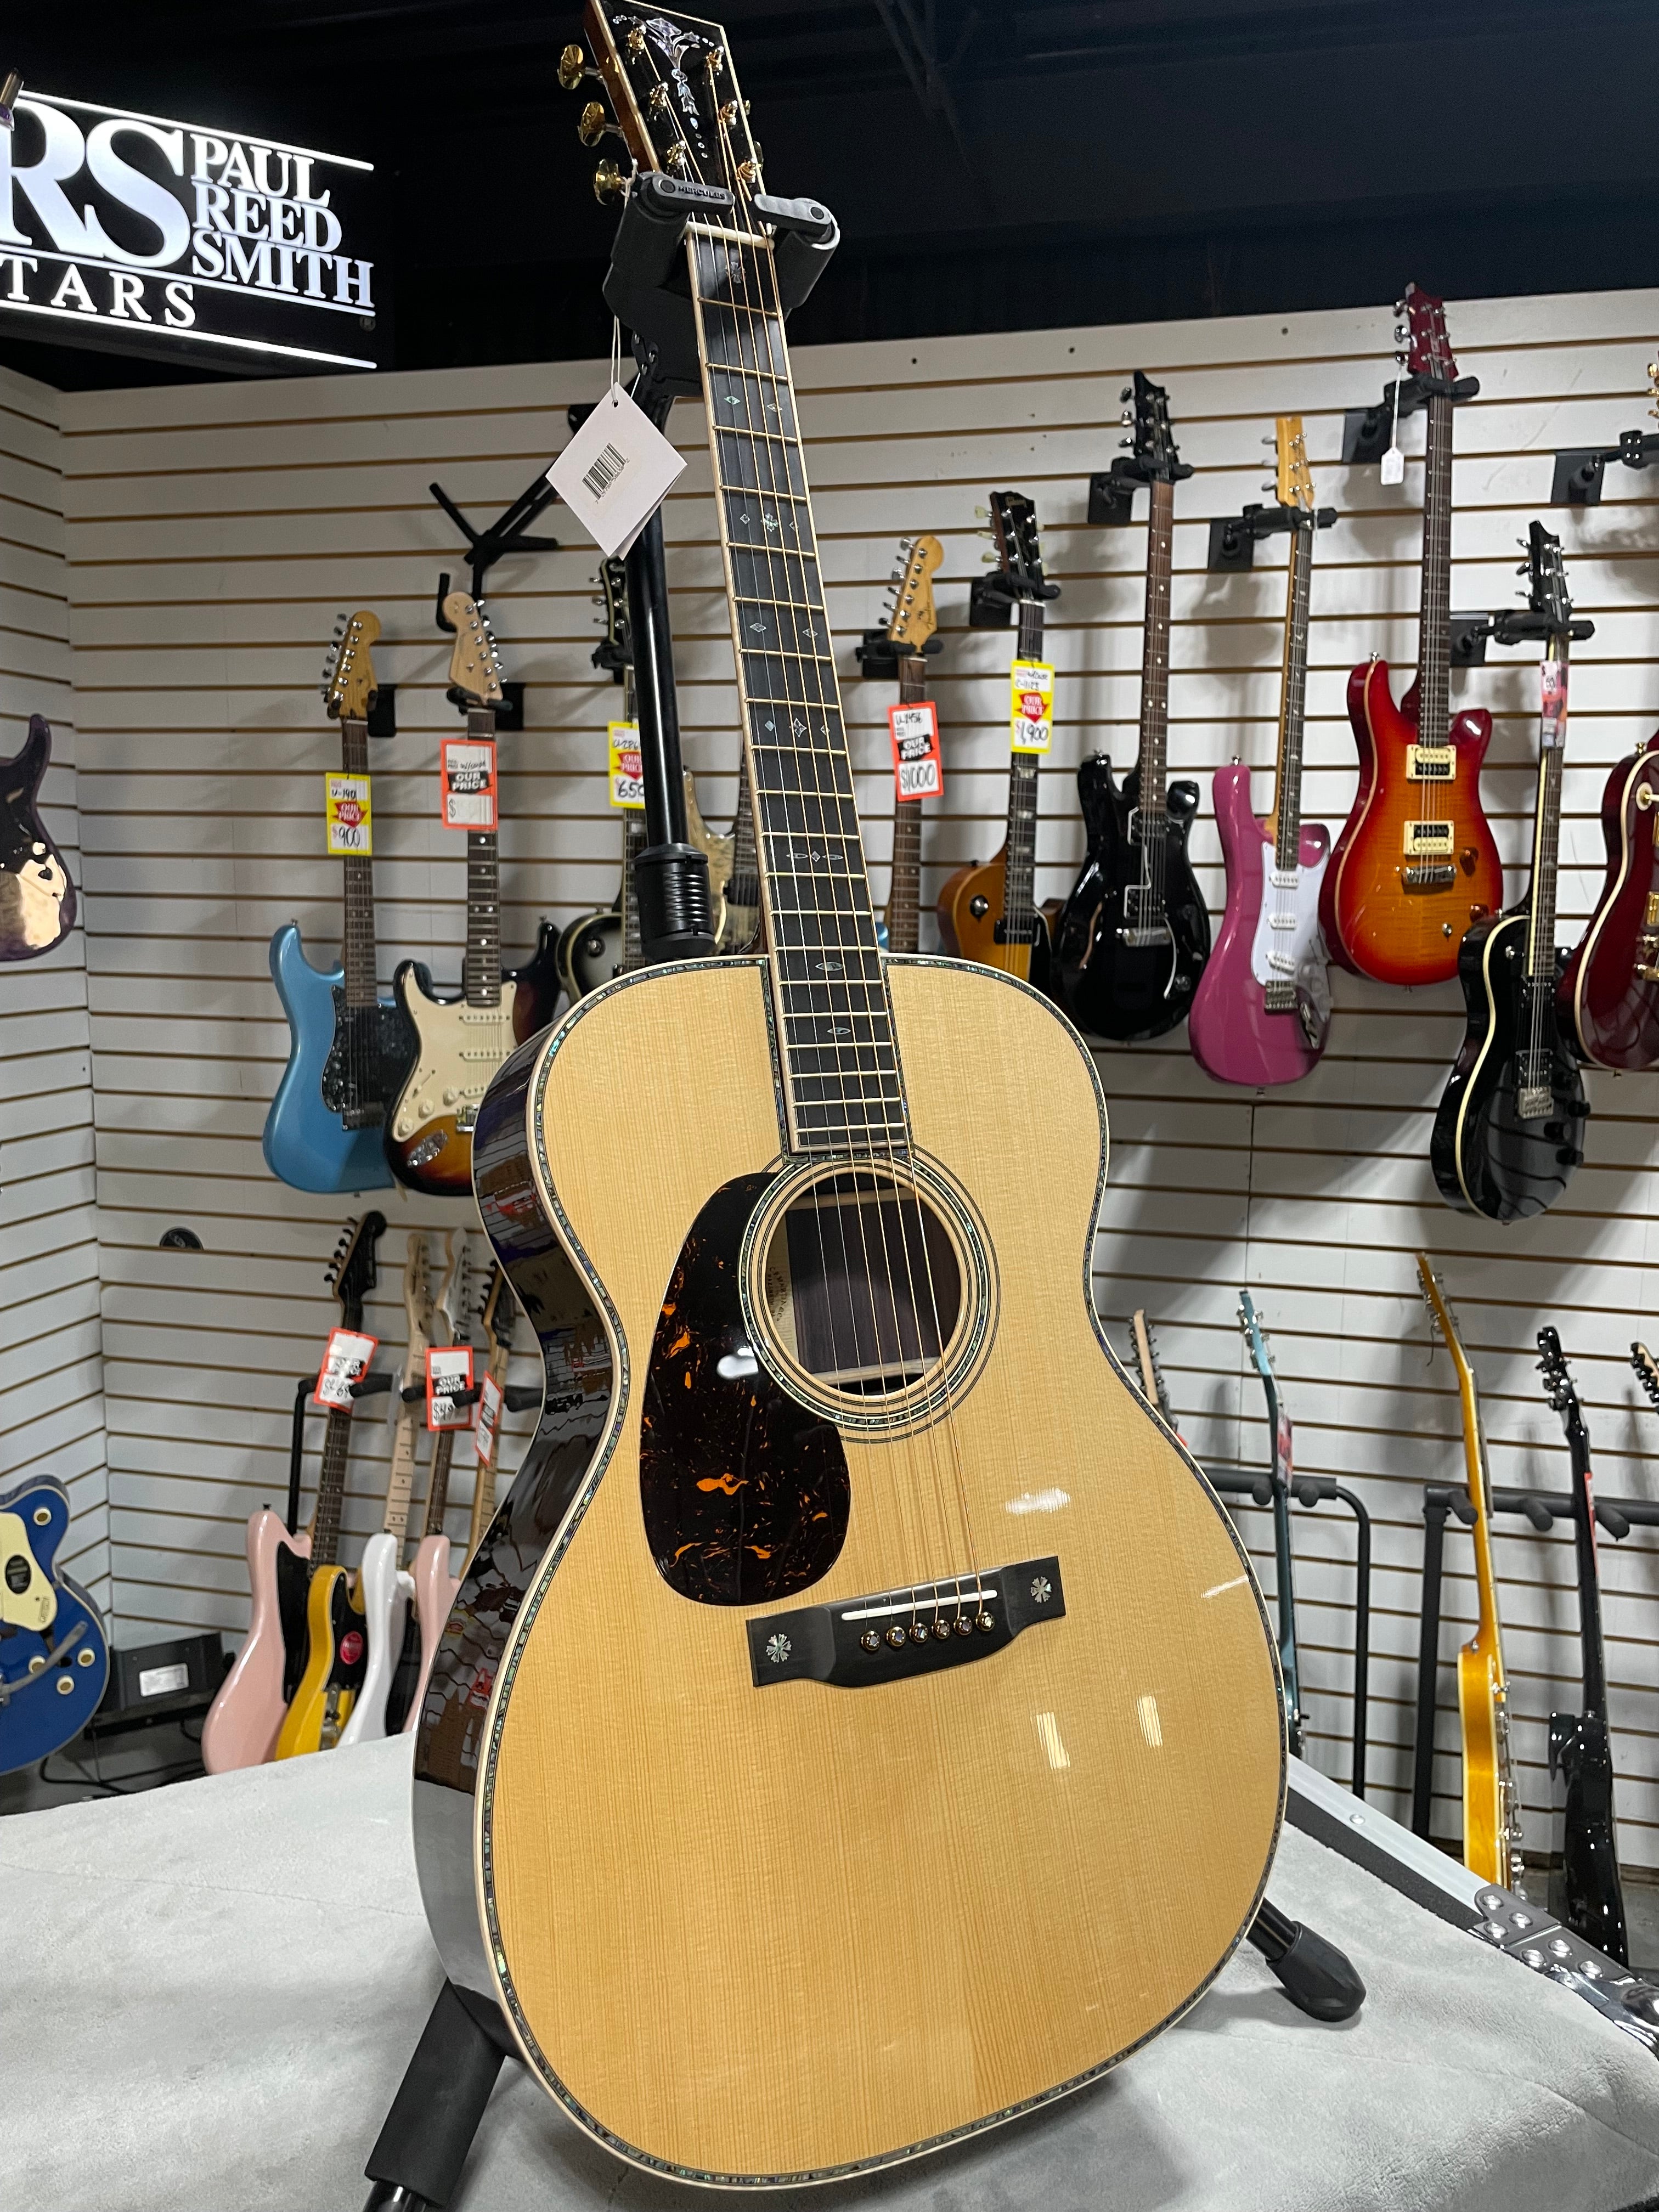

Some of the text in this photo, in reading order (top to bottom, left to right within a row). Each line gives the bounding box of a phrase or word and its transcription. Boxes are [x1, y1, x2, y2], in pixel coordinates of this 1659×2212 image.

[190, 133, 330, 207] PAUL
[678, 185, 725, 200] HERCULES
[191, 181, 342, 253] REED
[193, 230, 375, 307] SMITH
[903, 737, 924, 749] OUR
[901, 743, 931, 760] PRICE
[456, 772, 481, 782] OUR
[452, 779, 487, 791] PRICE
[435, 1380, 466, 1396] PRICE
[439, 1374, 460, 1387] OUR
